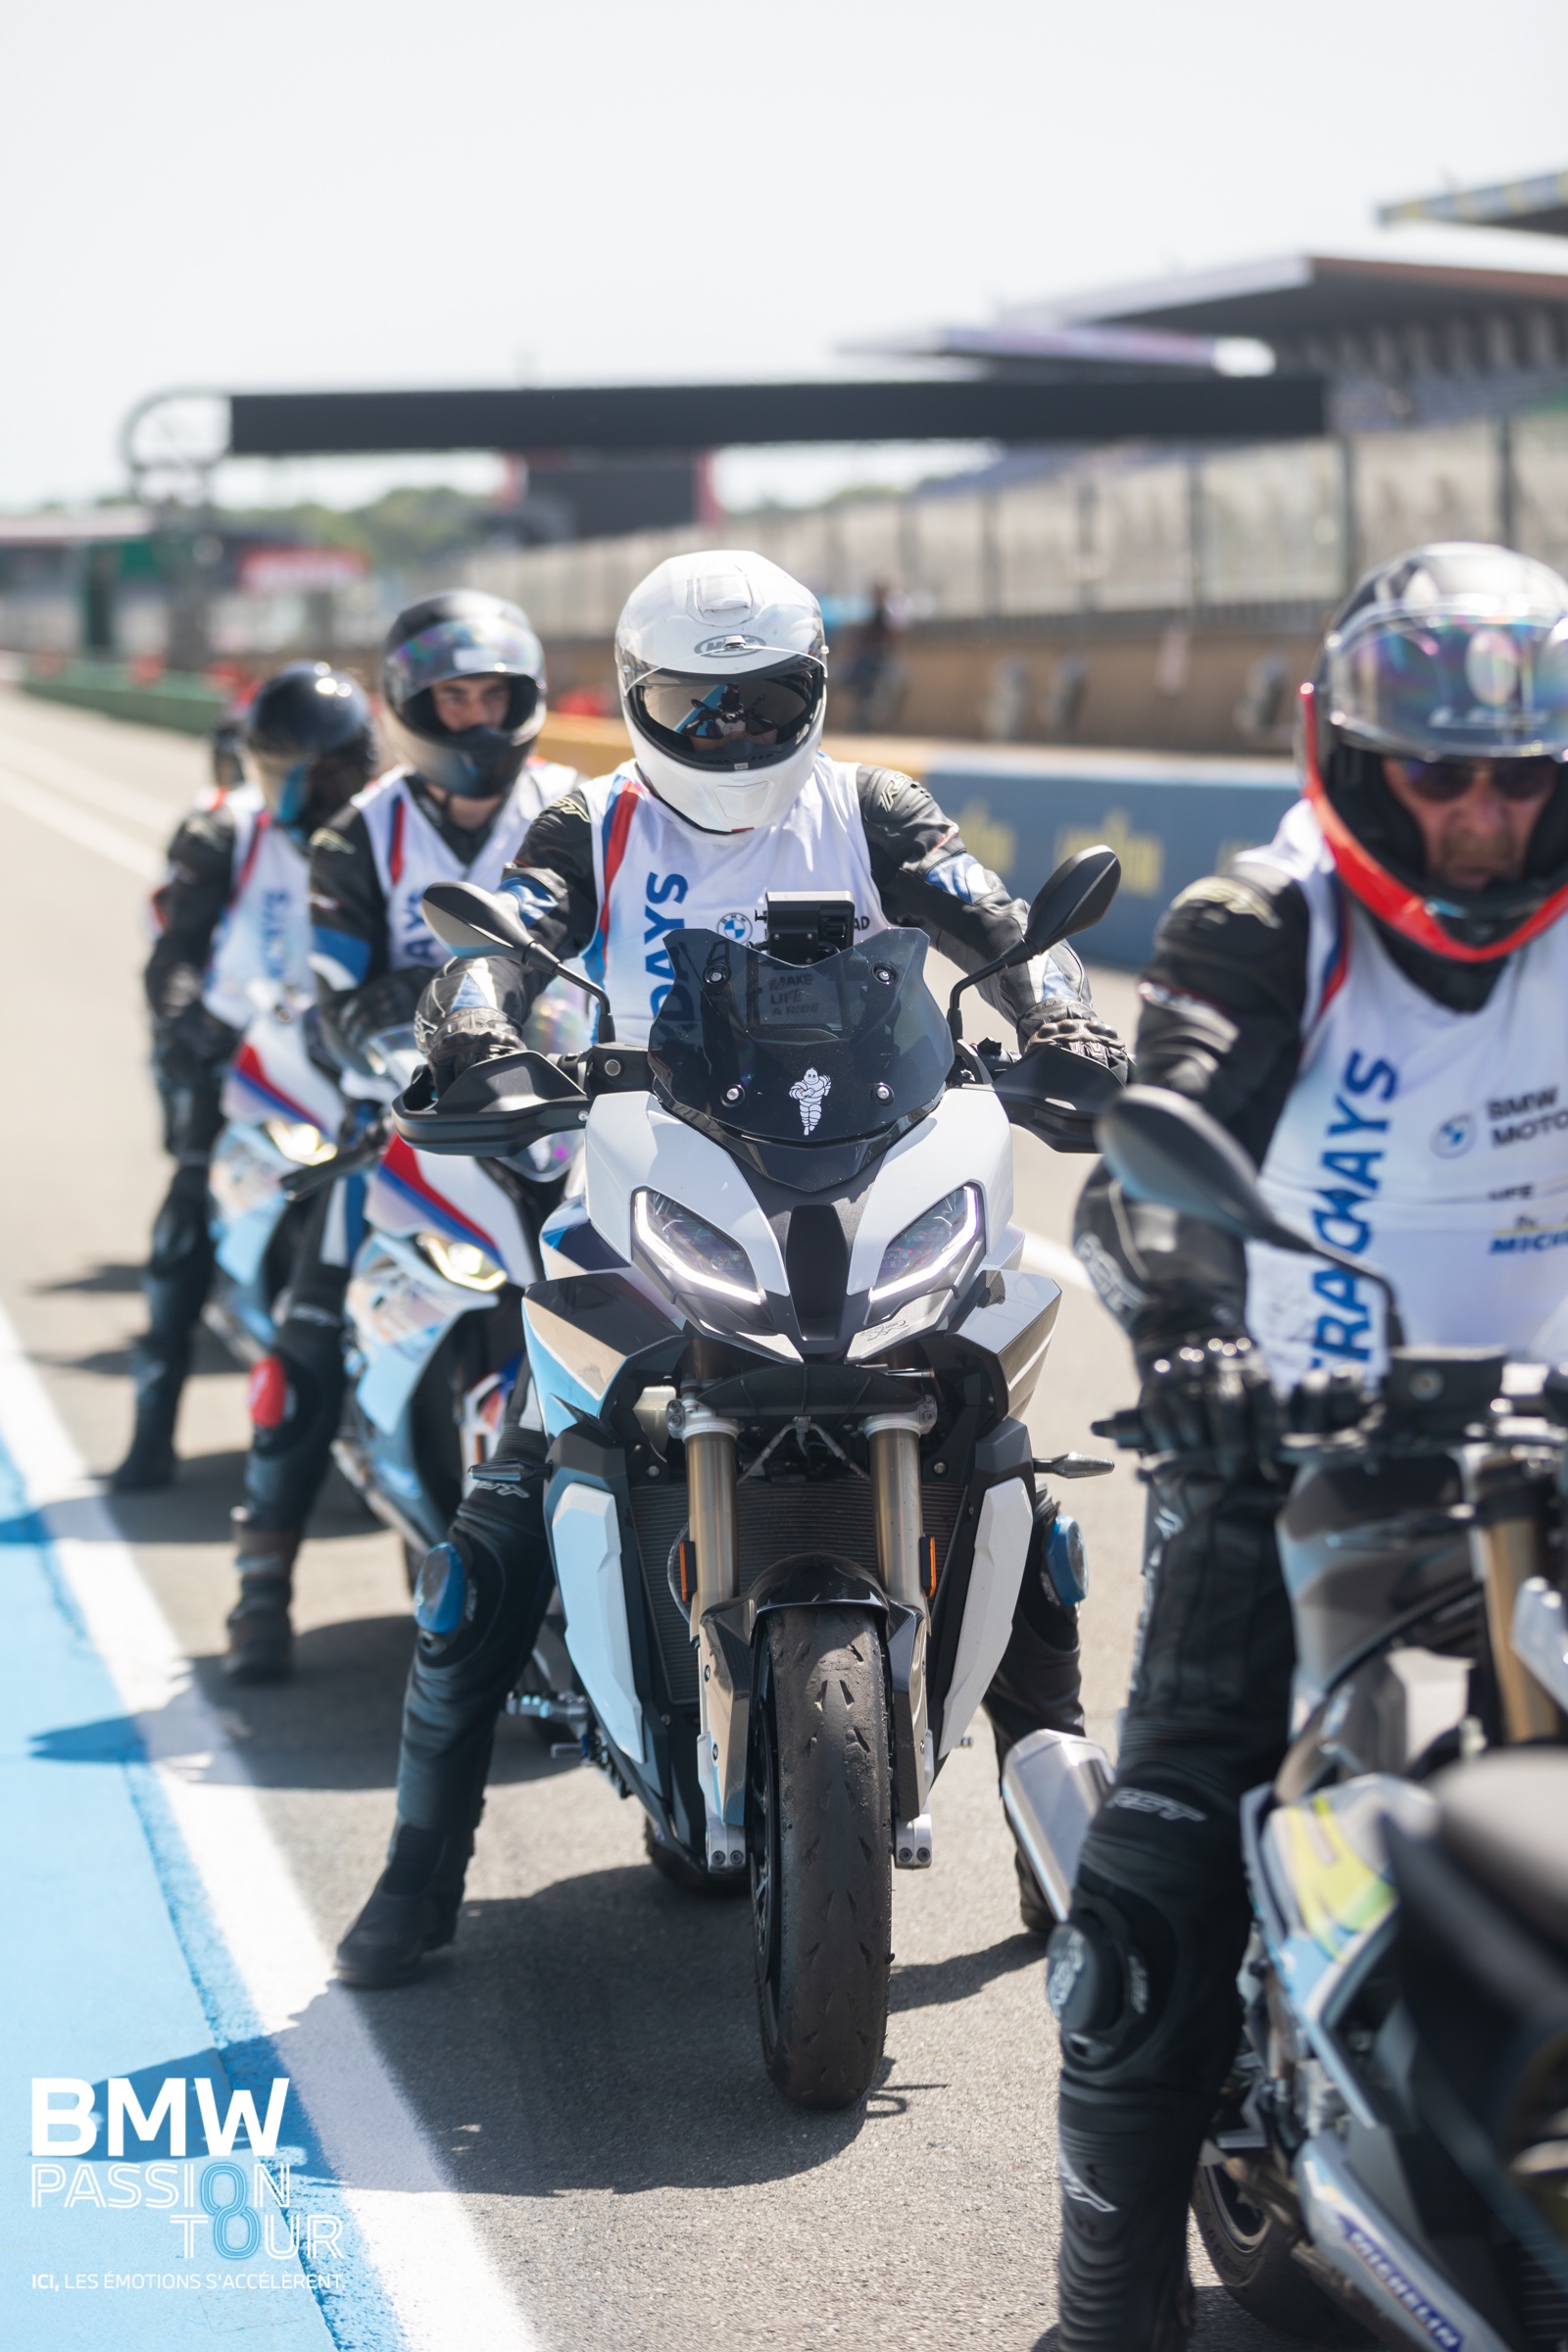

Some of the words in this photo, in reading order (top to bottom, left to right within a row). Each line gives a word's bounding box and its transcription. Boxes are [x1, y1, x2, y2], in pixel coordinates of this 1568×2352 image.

[769, 974, 813, 990] MAKE
[771, 987, 803, 1004] LIFE
[1487, 1086, 1558, 1119] BMW
